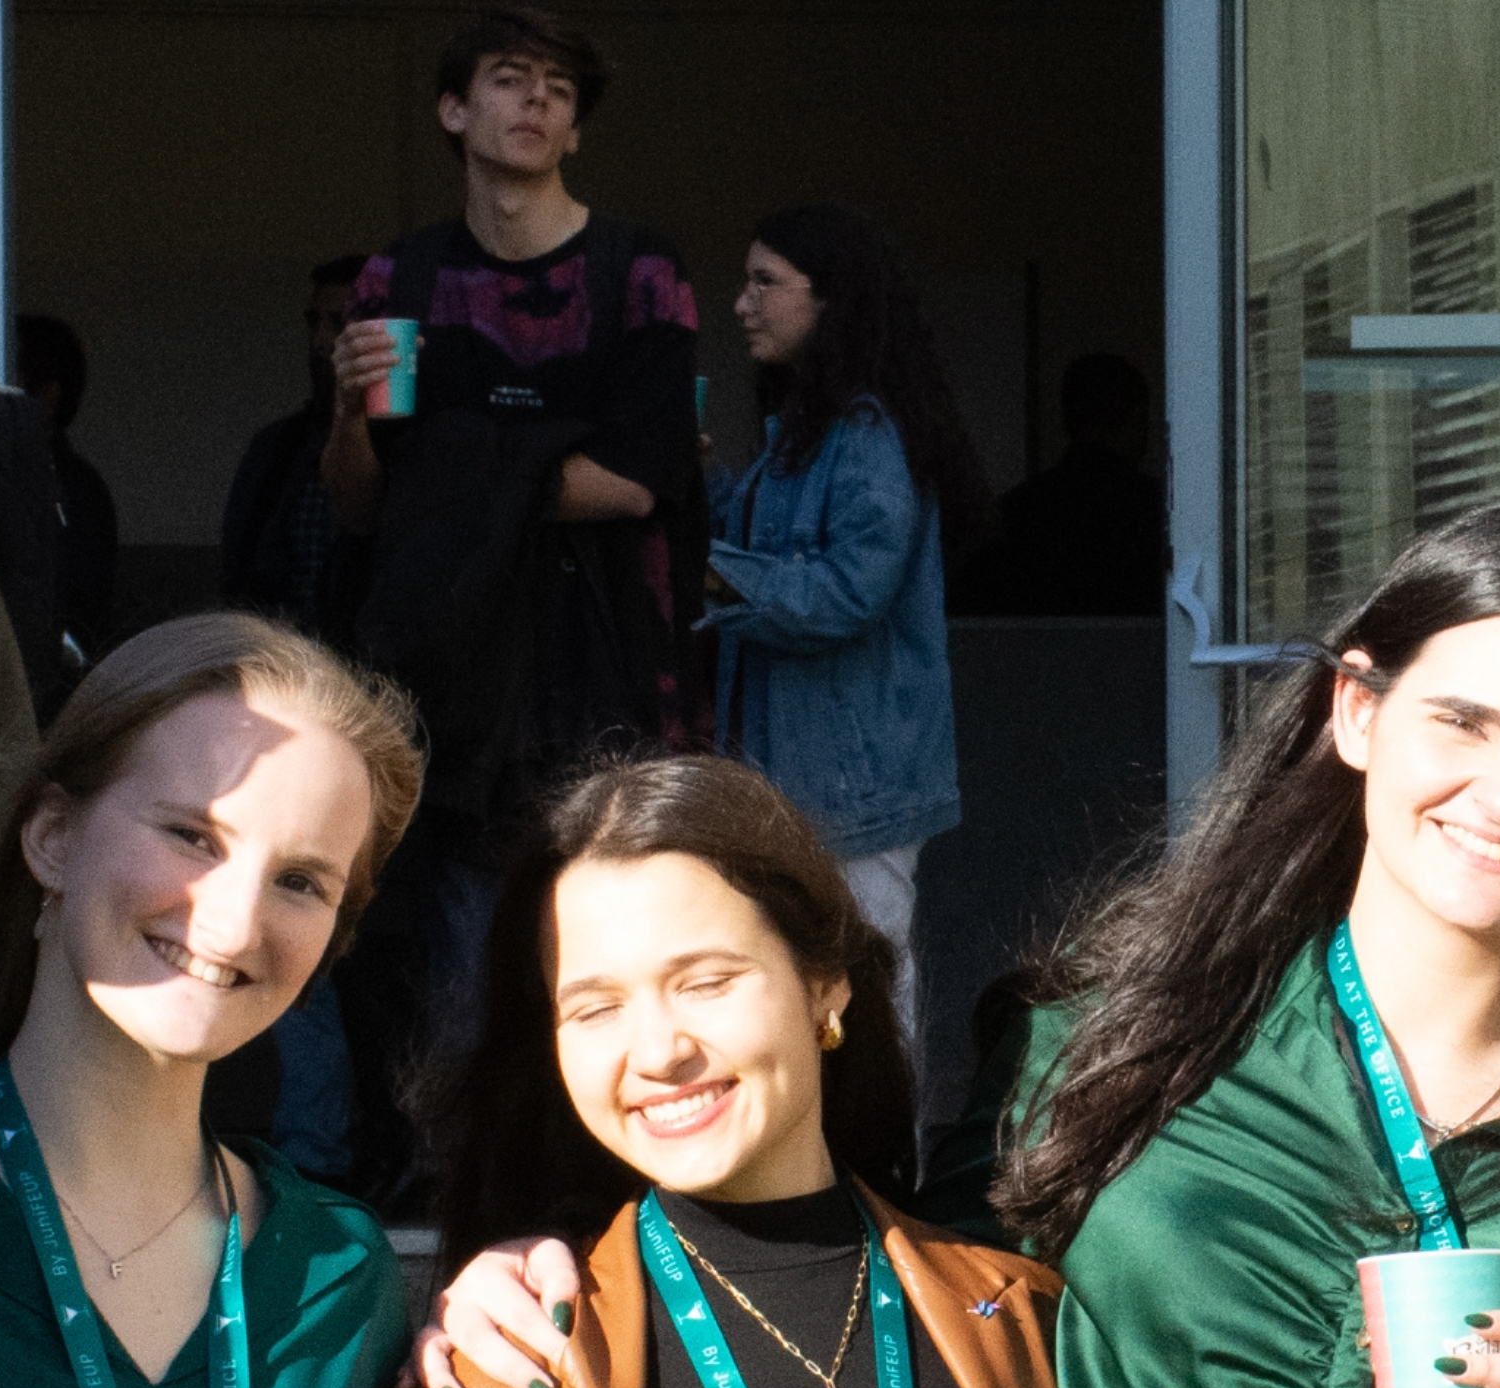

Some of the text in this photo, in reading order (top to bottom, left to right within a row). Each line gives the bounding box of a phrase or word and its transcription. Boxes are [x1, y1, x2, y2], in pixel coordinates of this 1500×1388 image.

[1336, 937, 1406, 1119] DAY AT THE OFFICE
[18, 1171, 58, 1248] JuniFEUP
[1419, 1189, 1453, 1250] ANOTH
[643, 1220, 684, 1283] JuniFEUP
[702, 1345, 722, 1367] By
